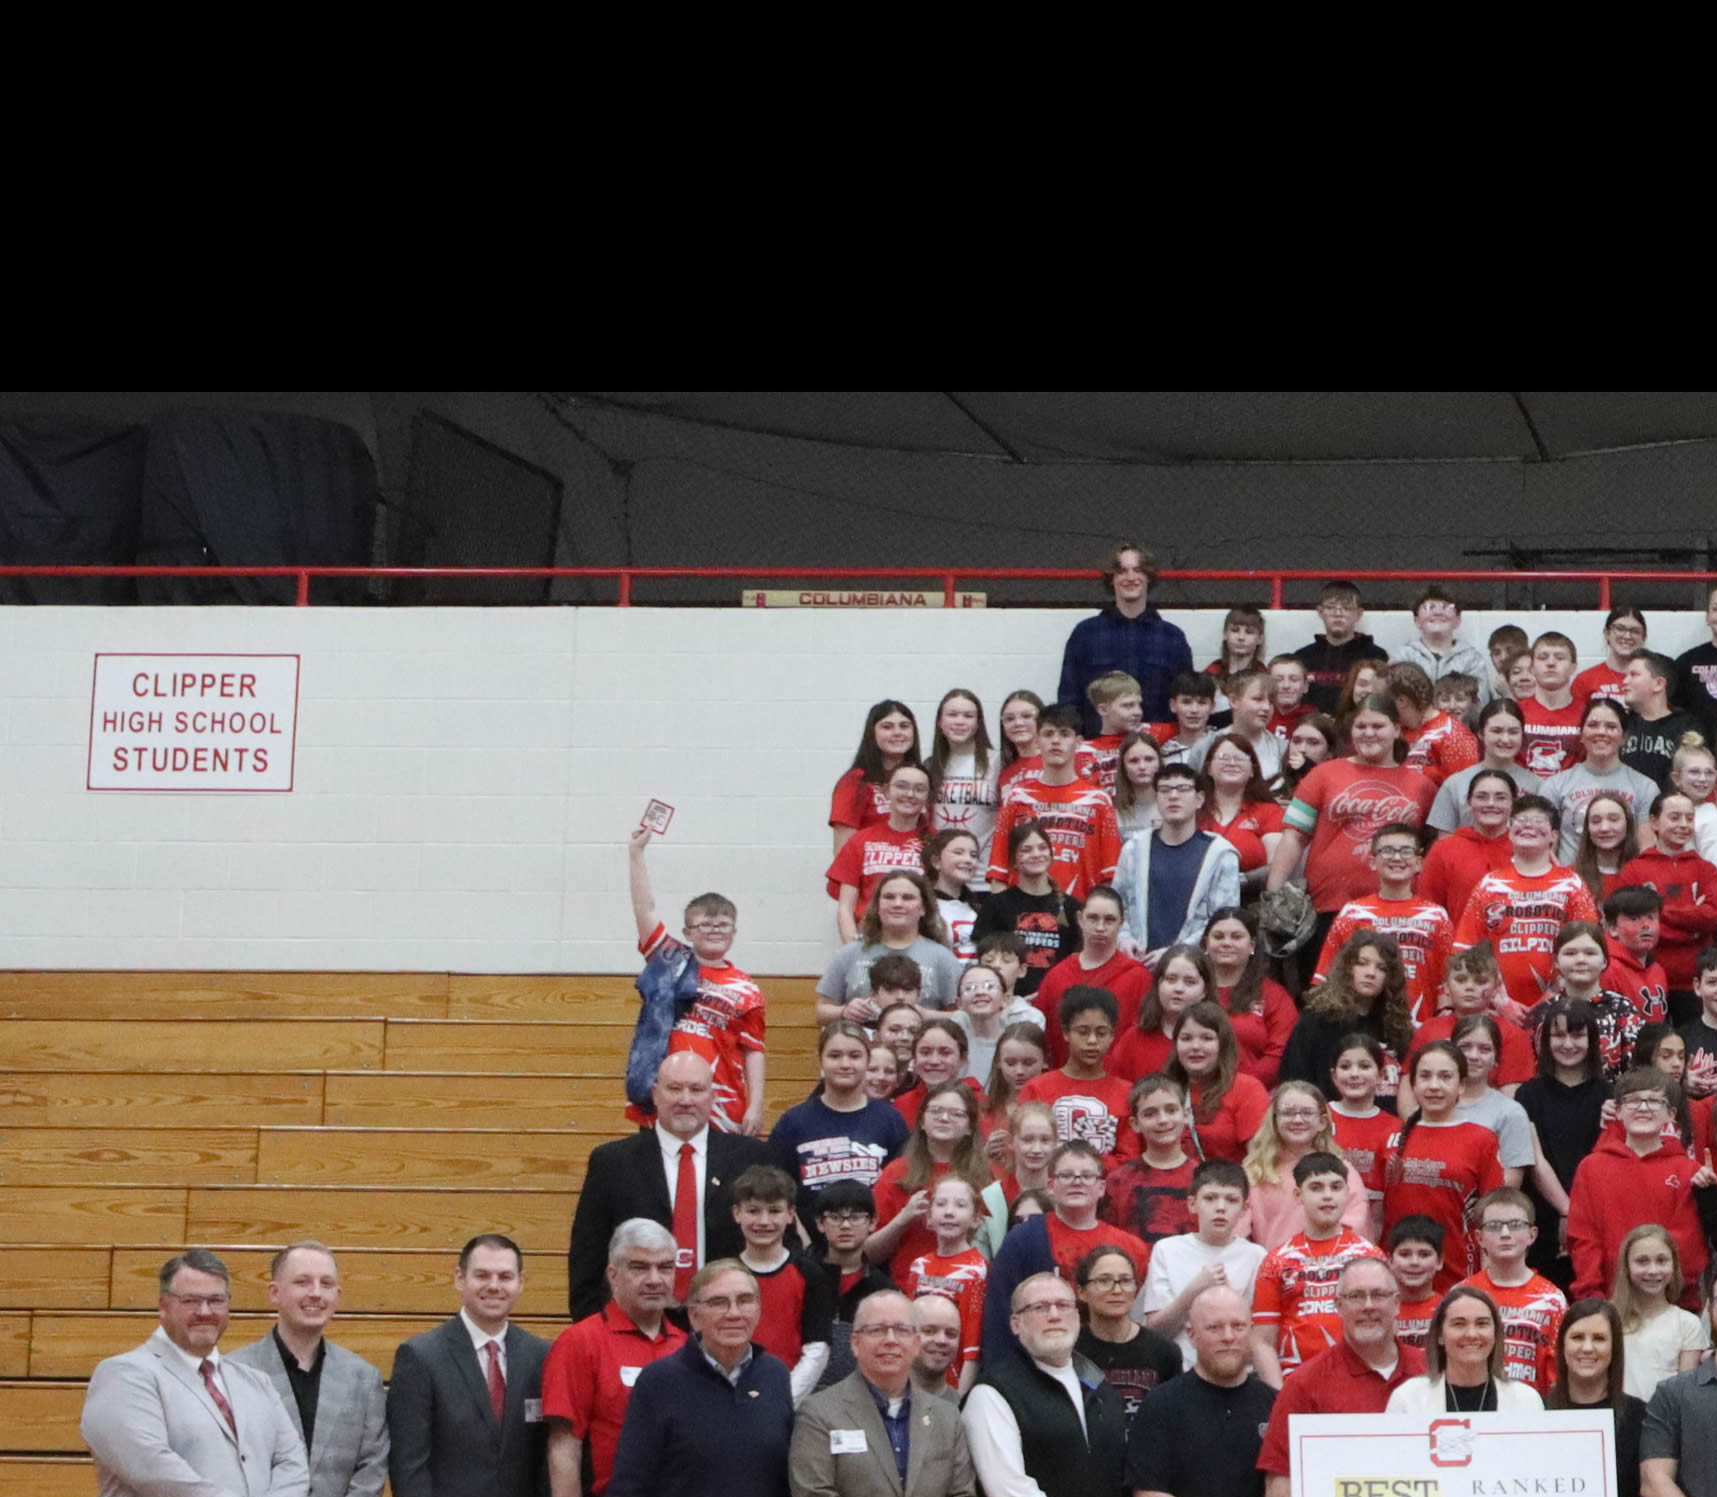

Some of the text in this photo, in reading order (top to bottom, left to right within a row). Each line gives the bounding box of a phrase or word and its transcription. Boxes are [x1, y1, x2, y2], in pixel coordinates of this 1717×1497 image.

[798, 592, 927, 607] COLUMBIANA
[132, 672, 257, 698] CLIPPER
[102, 711, 283, 734] HIGH SCHOOL
[112, 747, 269, 772] STUDENTS
[804, 1157, 879, 1179] NEWSIES
[1303, 1285, 1338, 1299] CLIPP
[1297, 1299, 1340, 1317] JONE
[1471, 1476, 1588, 1496] RANKED
